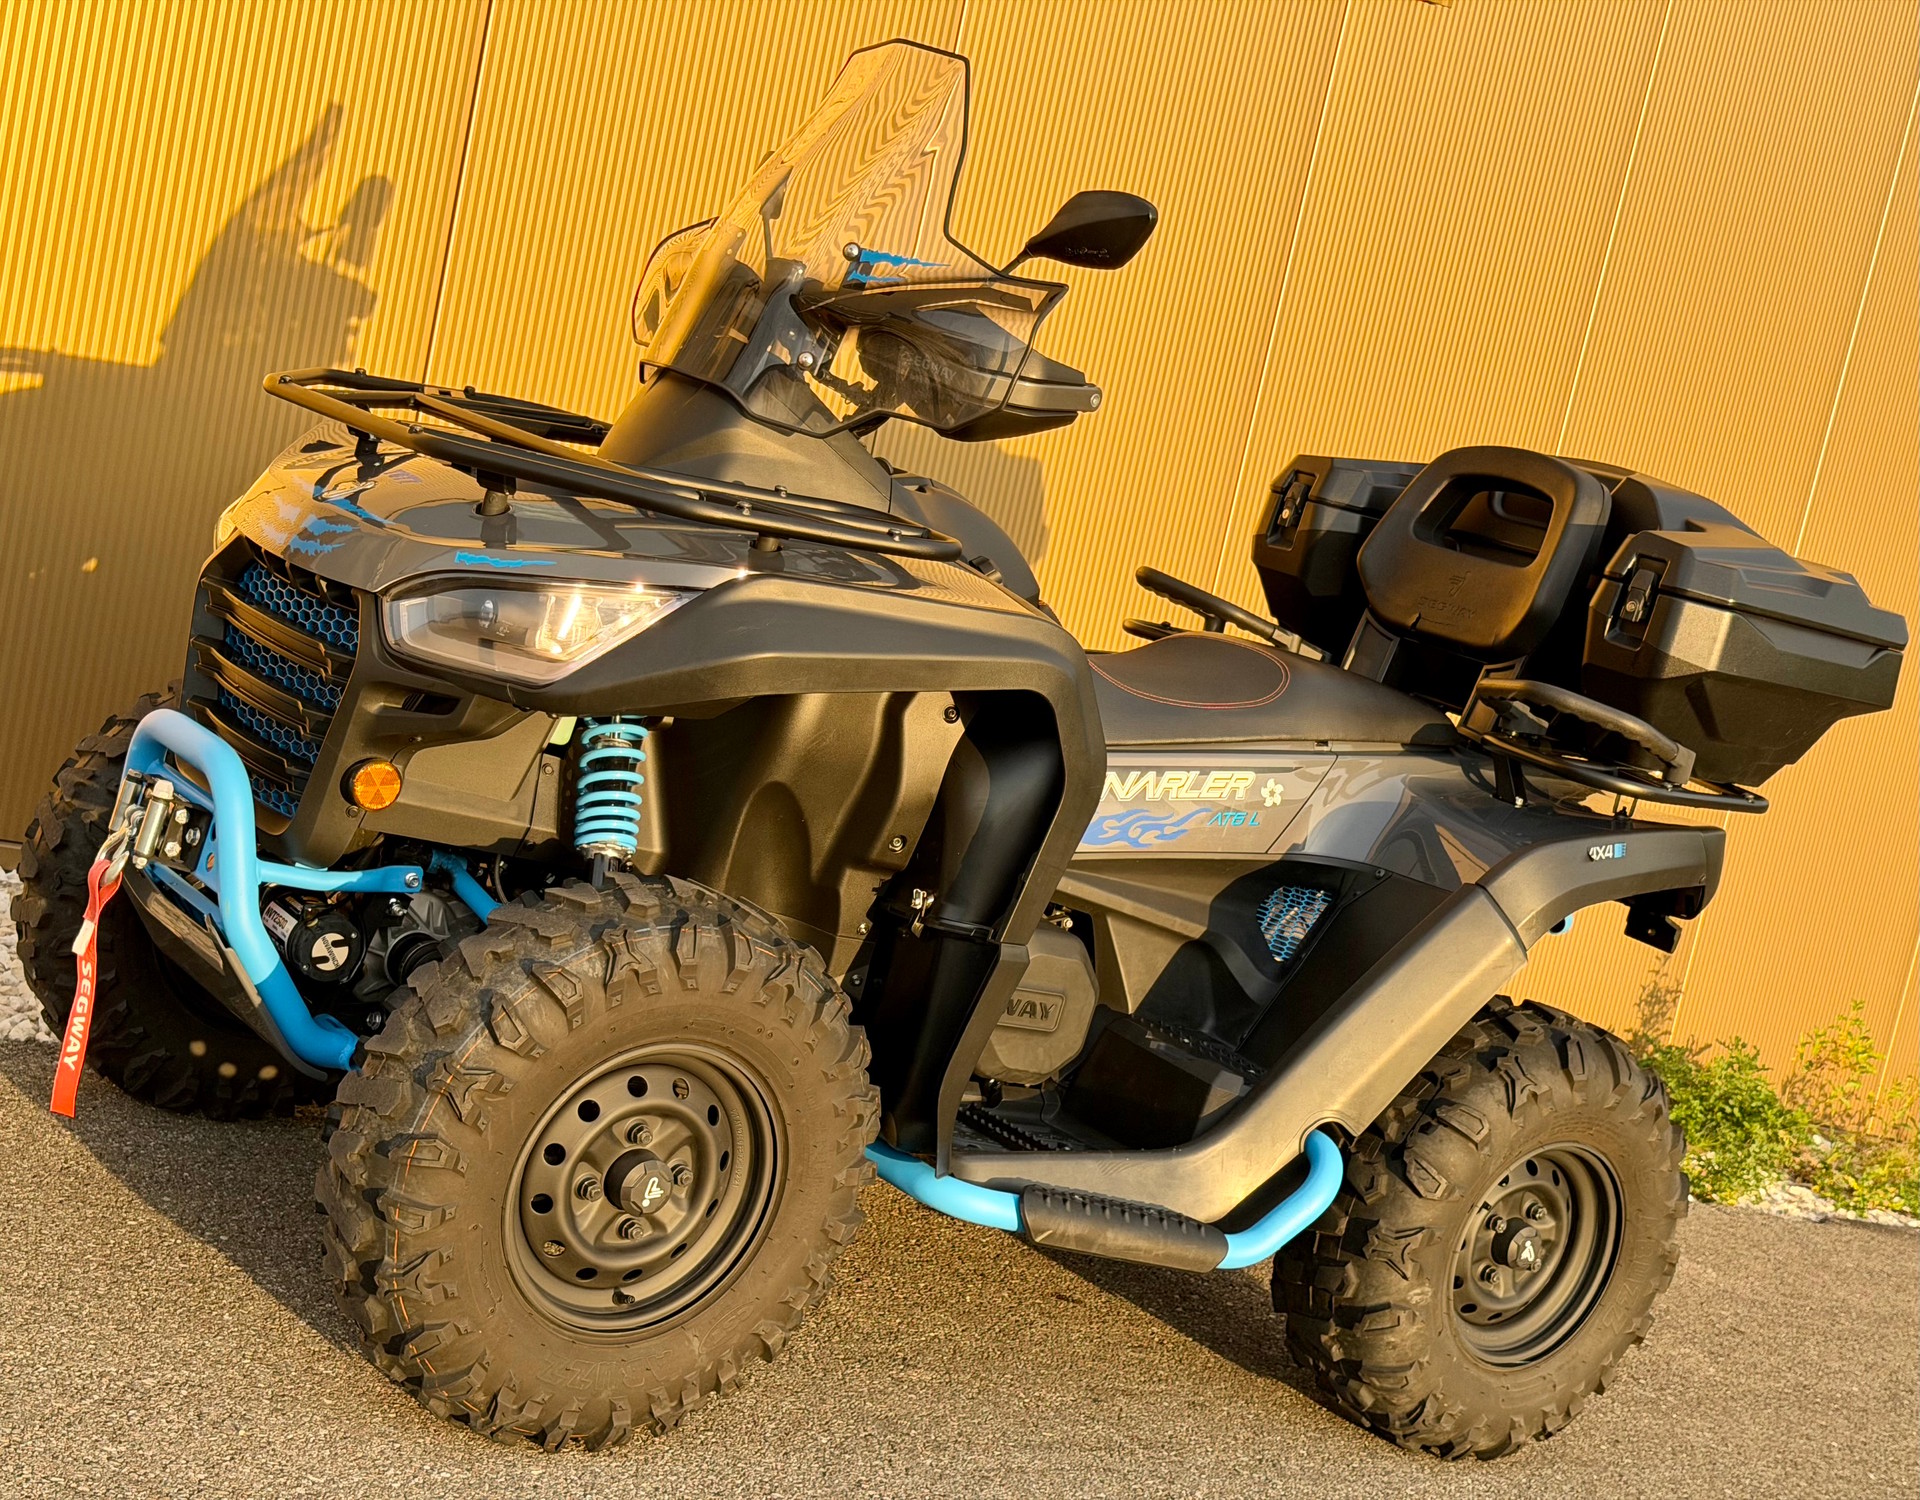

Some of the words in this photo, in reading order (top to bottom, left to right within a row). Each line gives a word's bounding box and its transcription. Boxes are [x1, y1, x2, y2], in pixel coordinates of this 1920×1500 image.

[1207, 812, 1248, 827] AT6
[1248, 812, 1261, 827] L
[1588, 844, 1613, 861] 4X4
[64, 959, 93, 1071] SEGWAY
